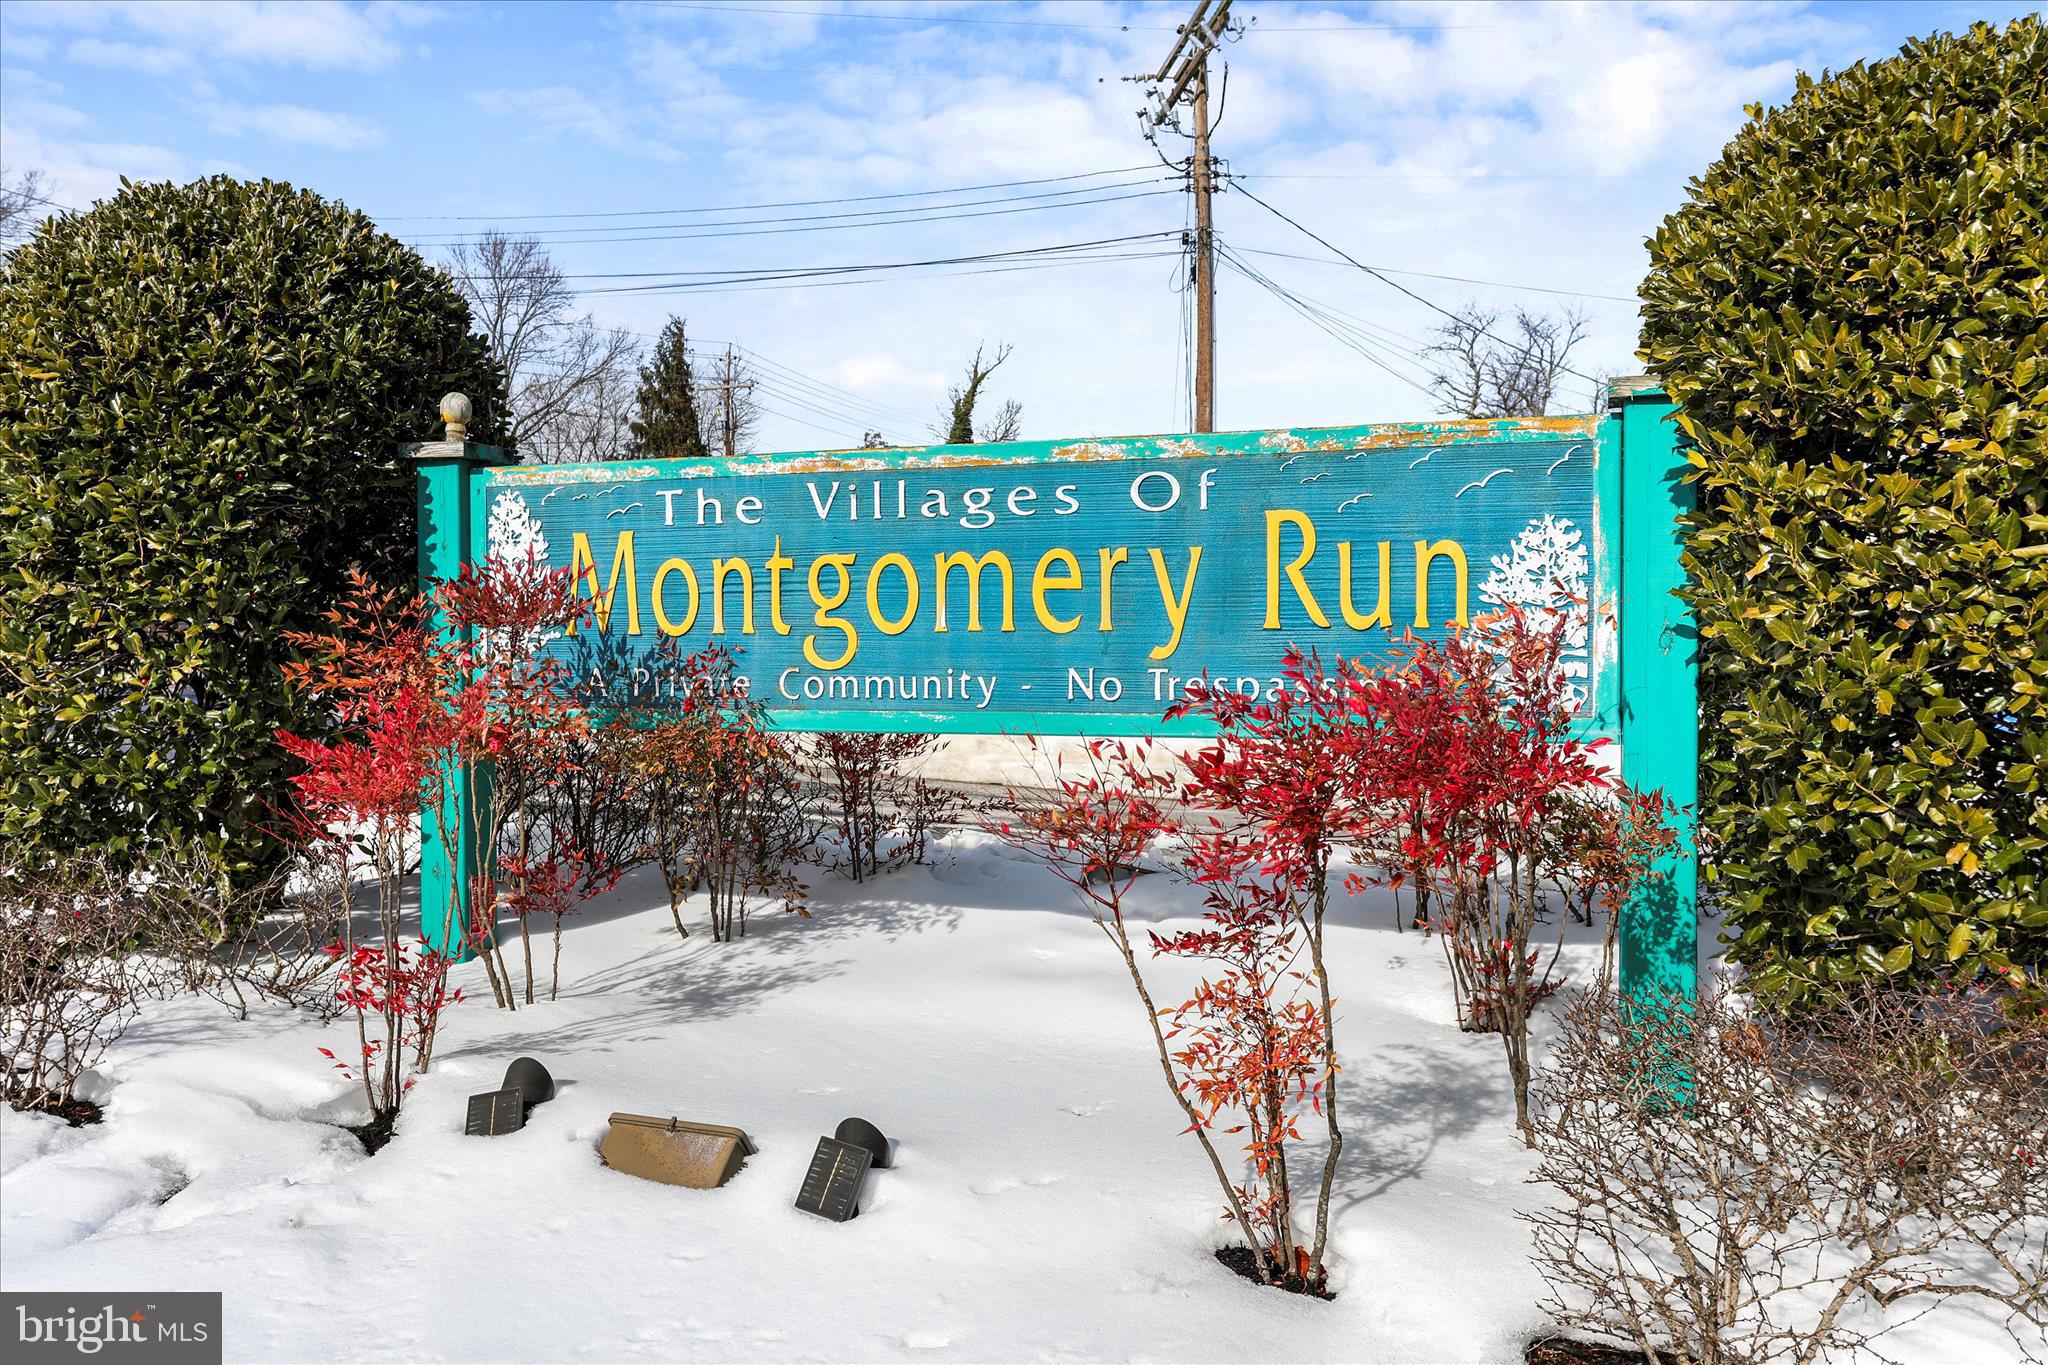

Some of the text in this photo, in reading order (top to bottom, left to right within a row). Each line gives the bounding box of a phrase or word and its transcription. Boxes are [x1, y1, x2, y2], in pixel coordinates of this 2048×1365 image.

[656, 468, 1217, 529] The Villages Of
[565, 509, 1469, 670] Montgomery Run
[586, 667, 608, 697] A
[633, 667, 751, 698] Private
[779, 667, 997, 709] Community
[1067, 667, 1123, 701] No
[1147, 668, 1408, 703] Trespass
